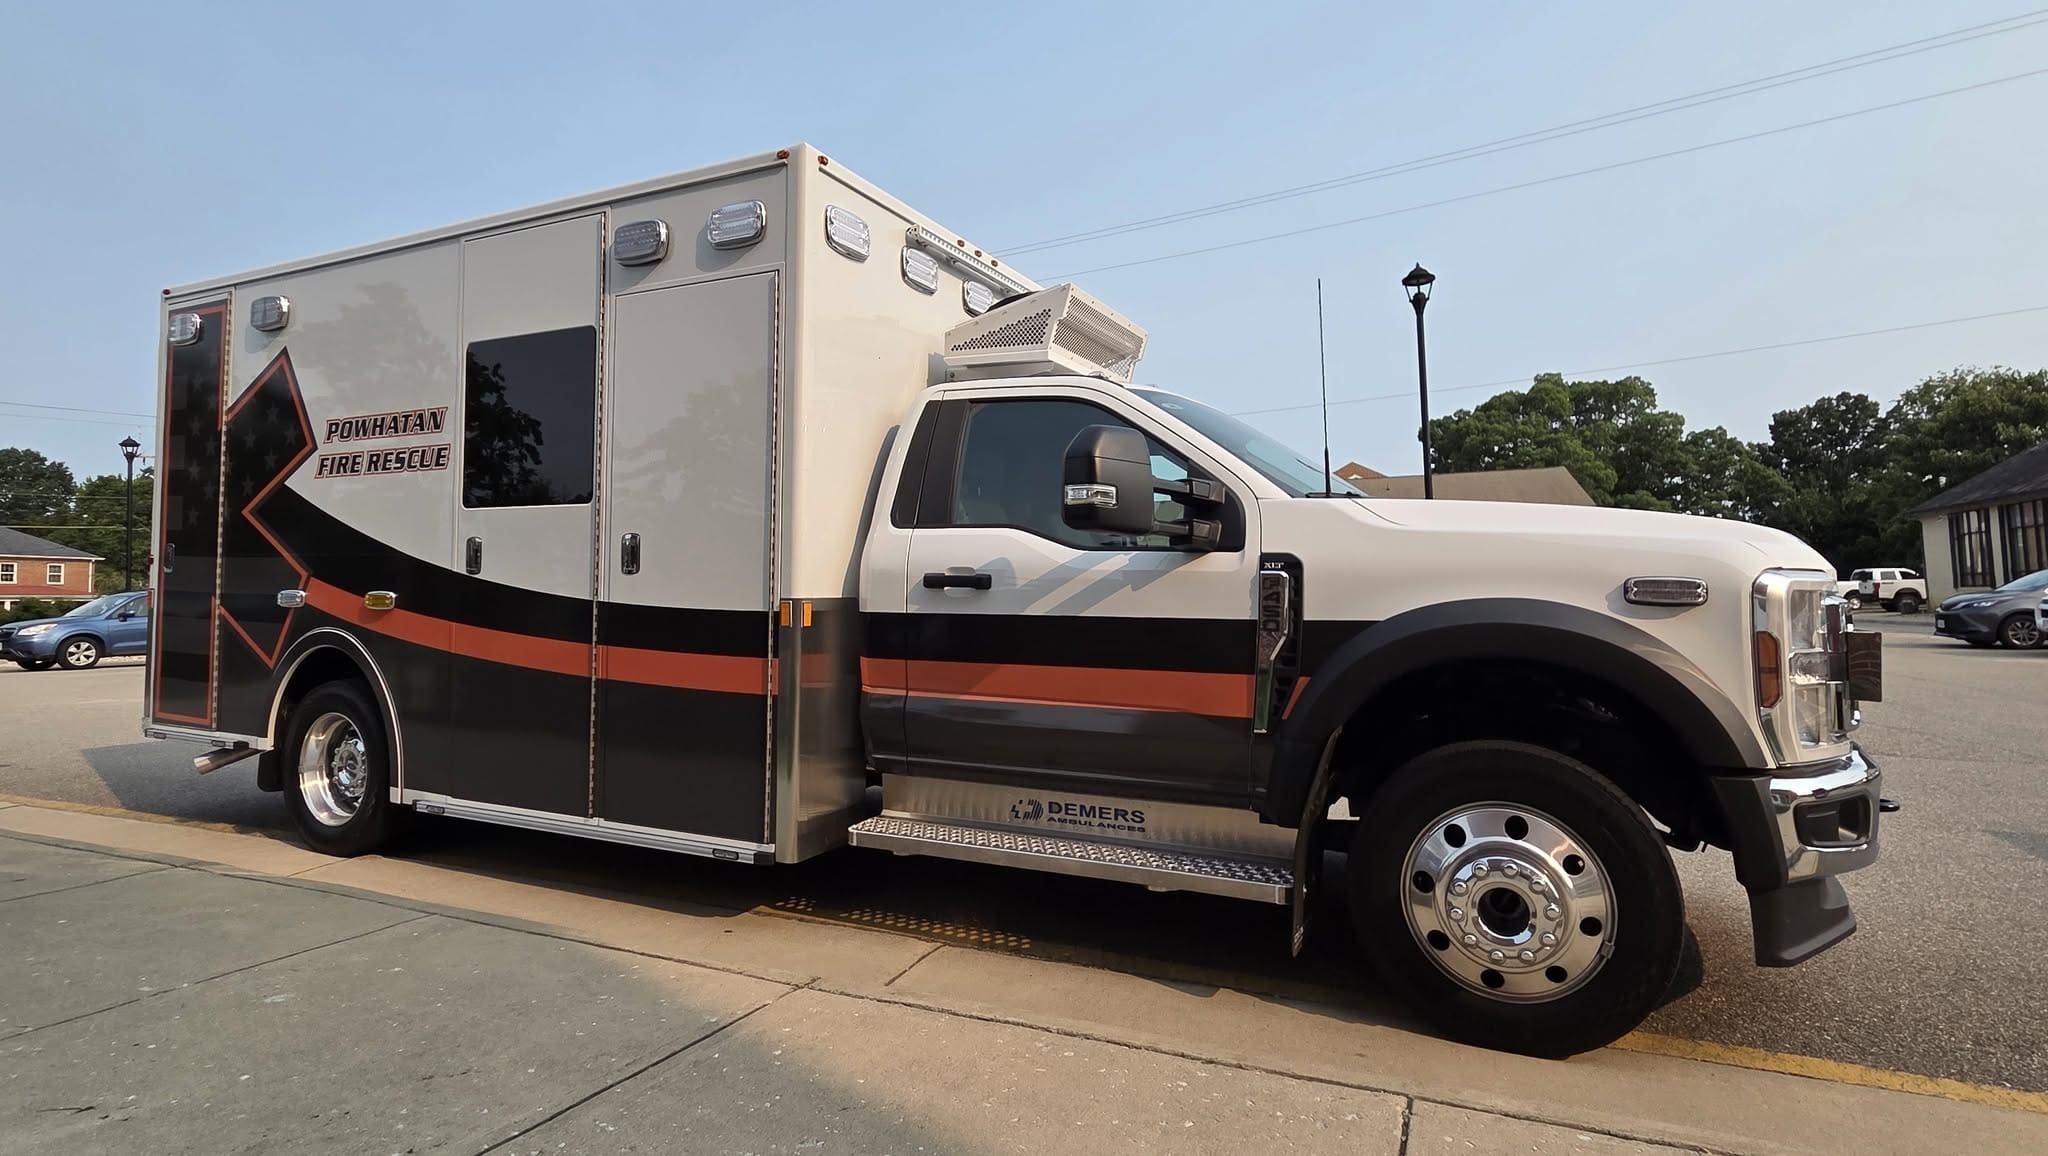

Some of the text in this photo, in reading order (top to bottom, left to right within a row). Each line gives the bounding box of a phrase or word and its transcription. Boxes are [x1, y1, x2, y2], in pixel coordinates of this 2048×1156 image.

[324, 408, 447, 443] POWHATAN
[315, 444, 450, 478] FIRE RESCUE
[1047, 817, 1146, 833] AMBULANCES
[1048, 801, 1145, 823] DEMERS
